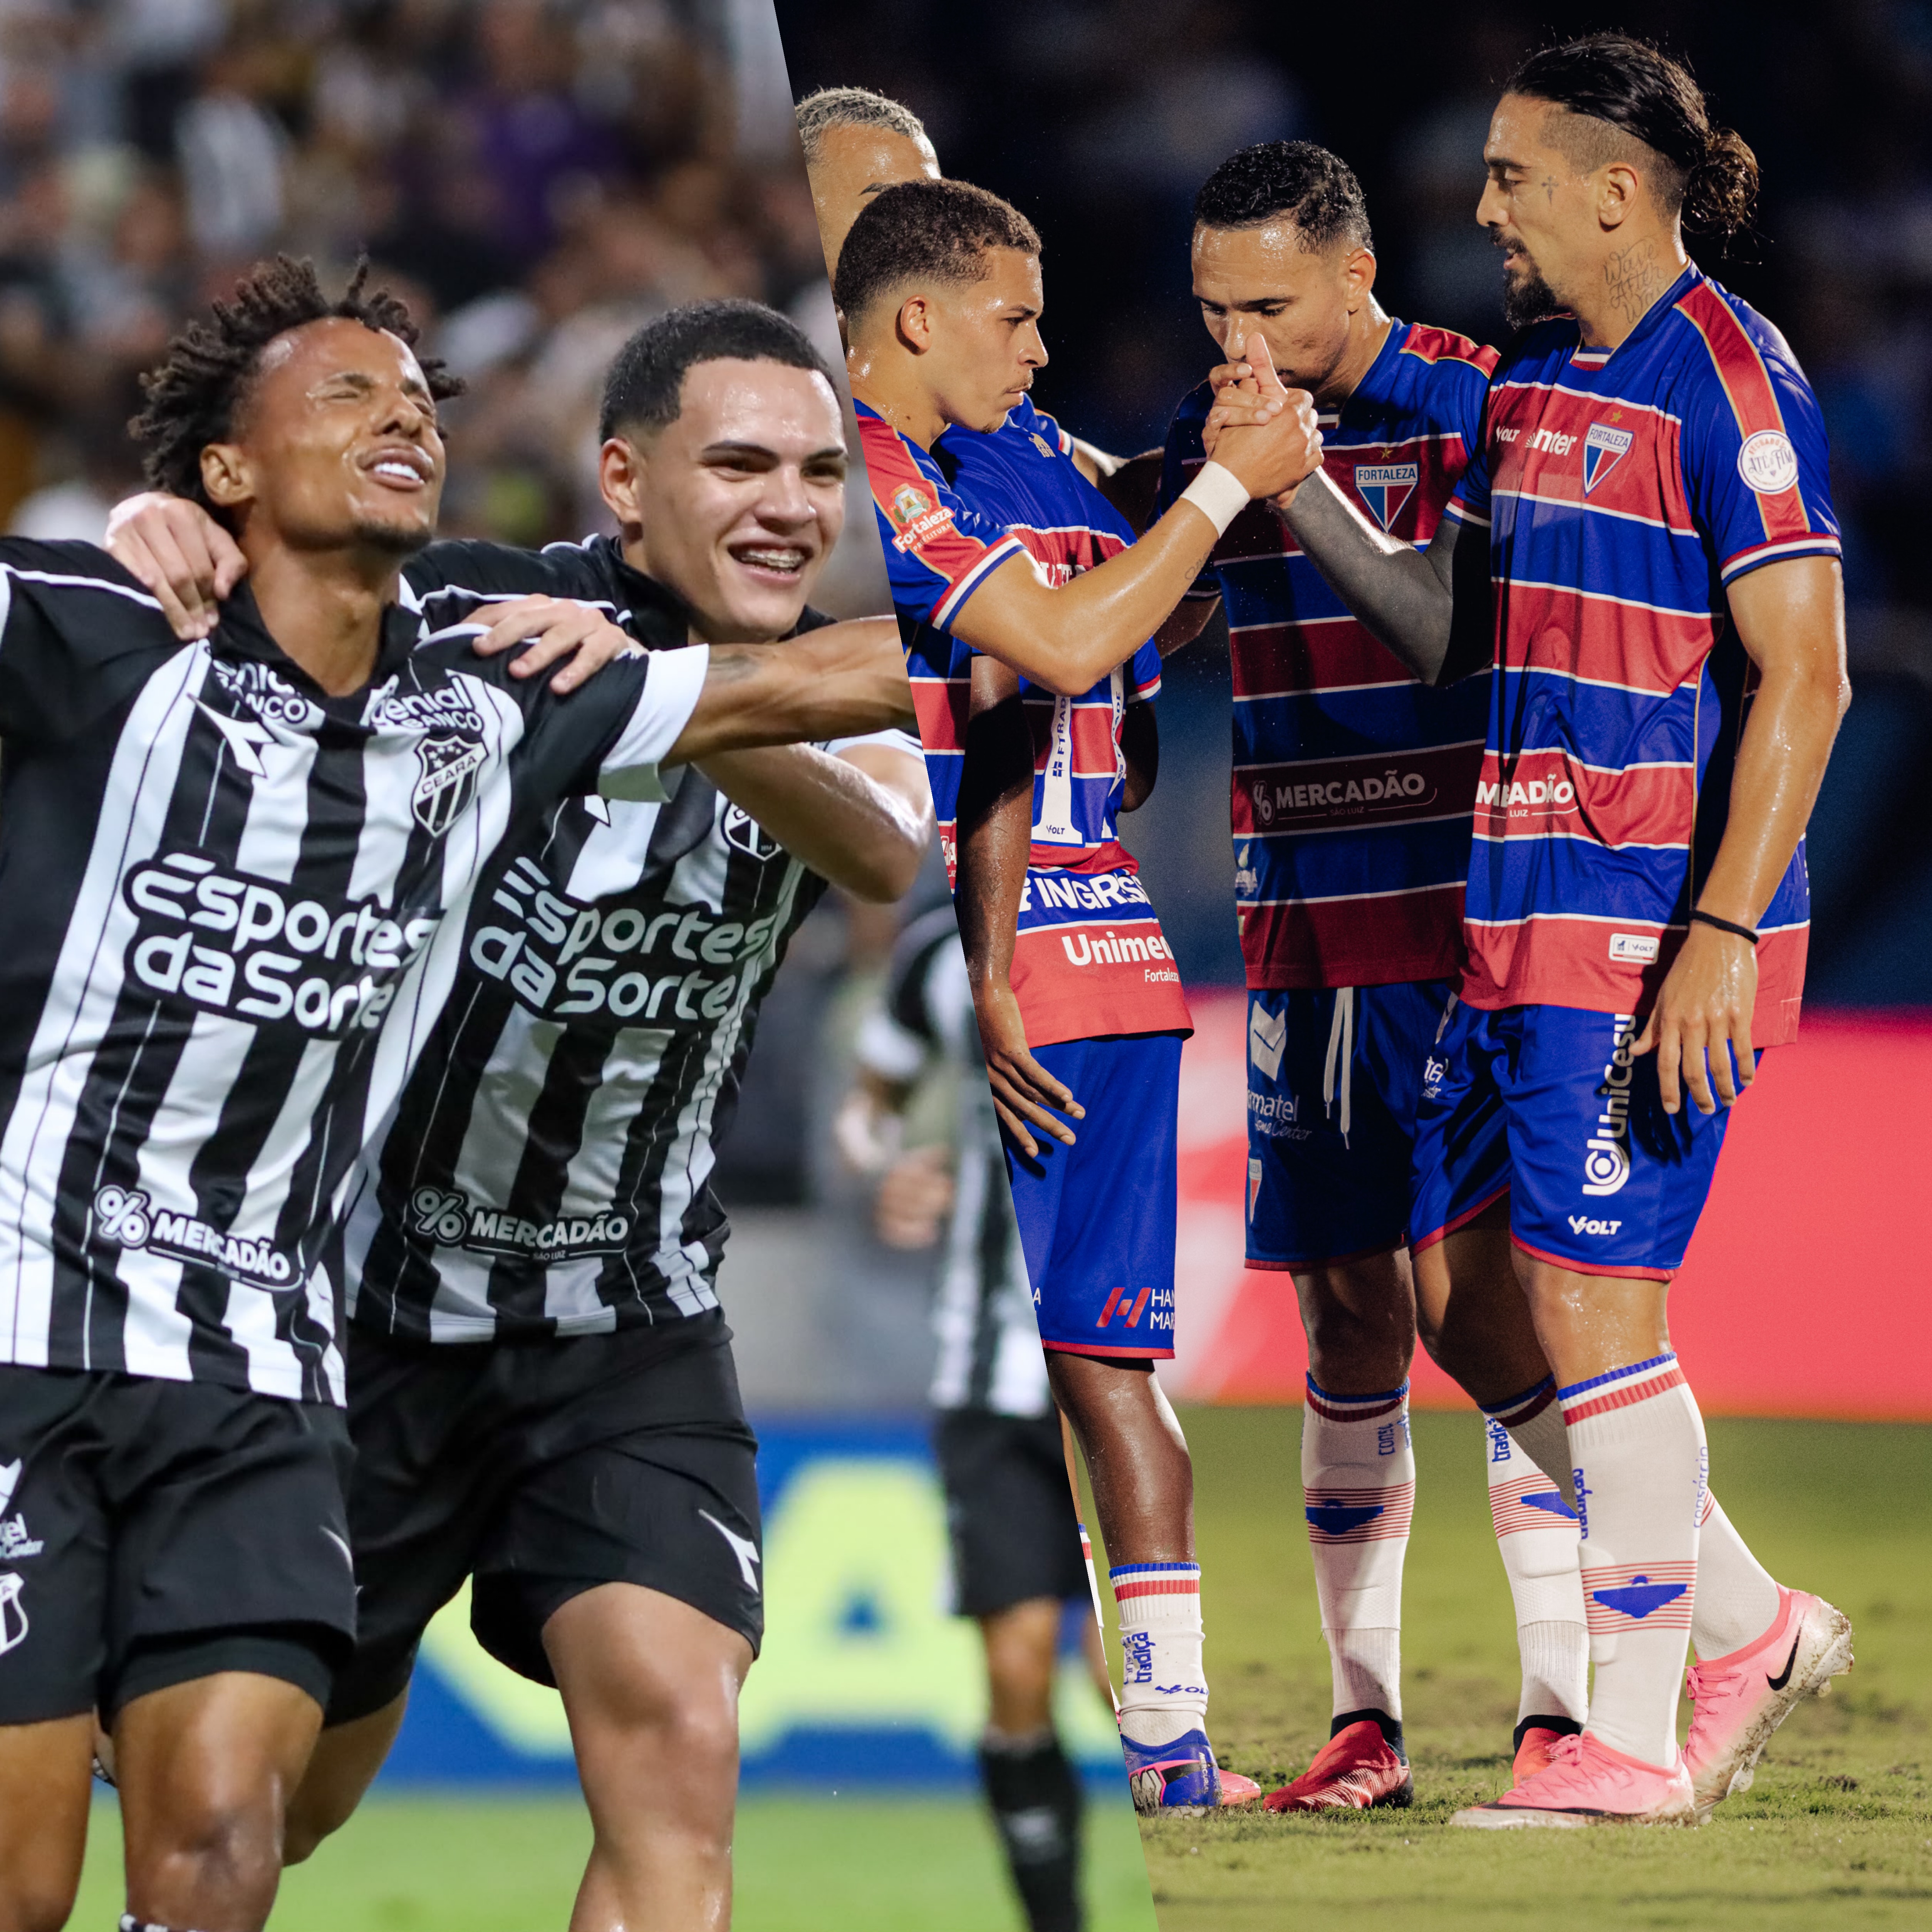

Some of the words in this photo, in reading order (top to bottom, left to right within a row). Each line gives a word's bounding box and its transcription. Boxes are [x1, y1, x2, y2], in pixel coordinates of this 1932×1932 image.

[1589, 428, 1629, 448] FORTALEZA
[1358, 467, 1416, 481] FORTALEZA
[894, 508, 953, 551] Fortaleza
[1057, 696, 1067, 755] FTRAD
[1276, 770, 1426, 808] MERCADÃO
[1330, 806, 1345, 816] SÃO
[1347, 806, 1365, 815] LUIZ
[1509, 809, 1528, 817] LUIZ
[1046, 824, 1065, 835] VOLT
[493, 856, 776, 965] Esportes
[1632, 944, 1654, 952] VOLT
[1597, 1013, 1636, 1138] UniCesu
[471, 1211, 629, 1249] MERCADÃO
[1568, 1215, 1622, 1236] VOLT
